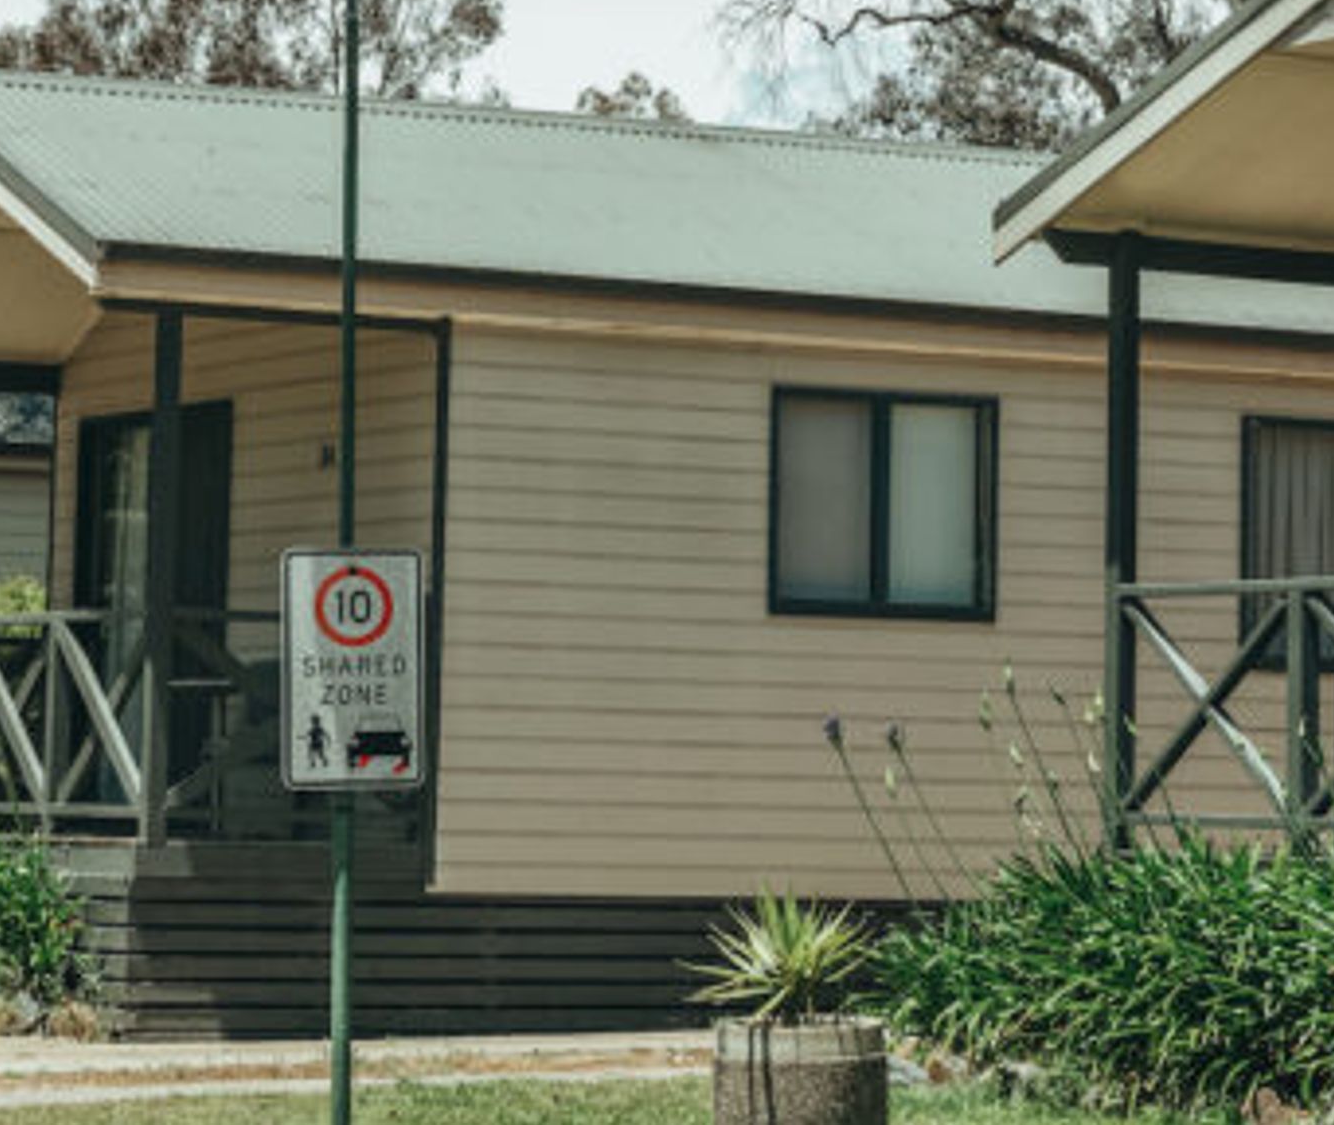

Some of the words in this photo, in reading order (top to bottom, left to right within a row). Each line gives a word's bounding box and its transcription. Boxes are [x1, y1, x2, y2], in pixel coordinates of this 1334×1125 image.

[335, 589, 371, 624] 10
[303, 654, 407, 678] SHARED
[321, 684, 388, 706] ZONE
